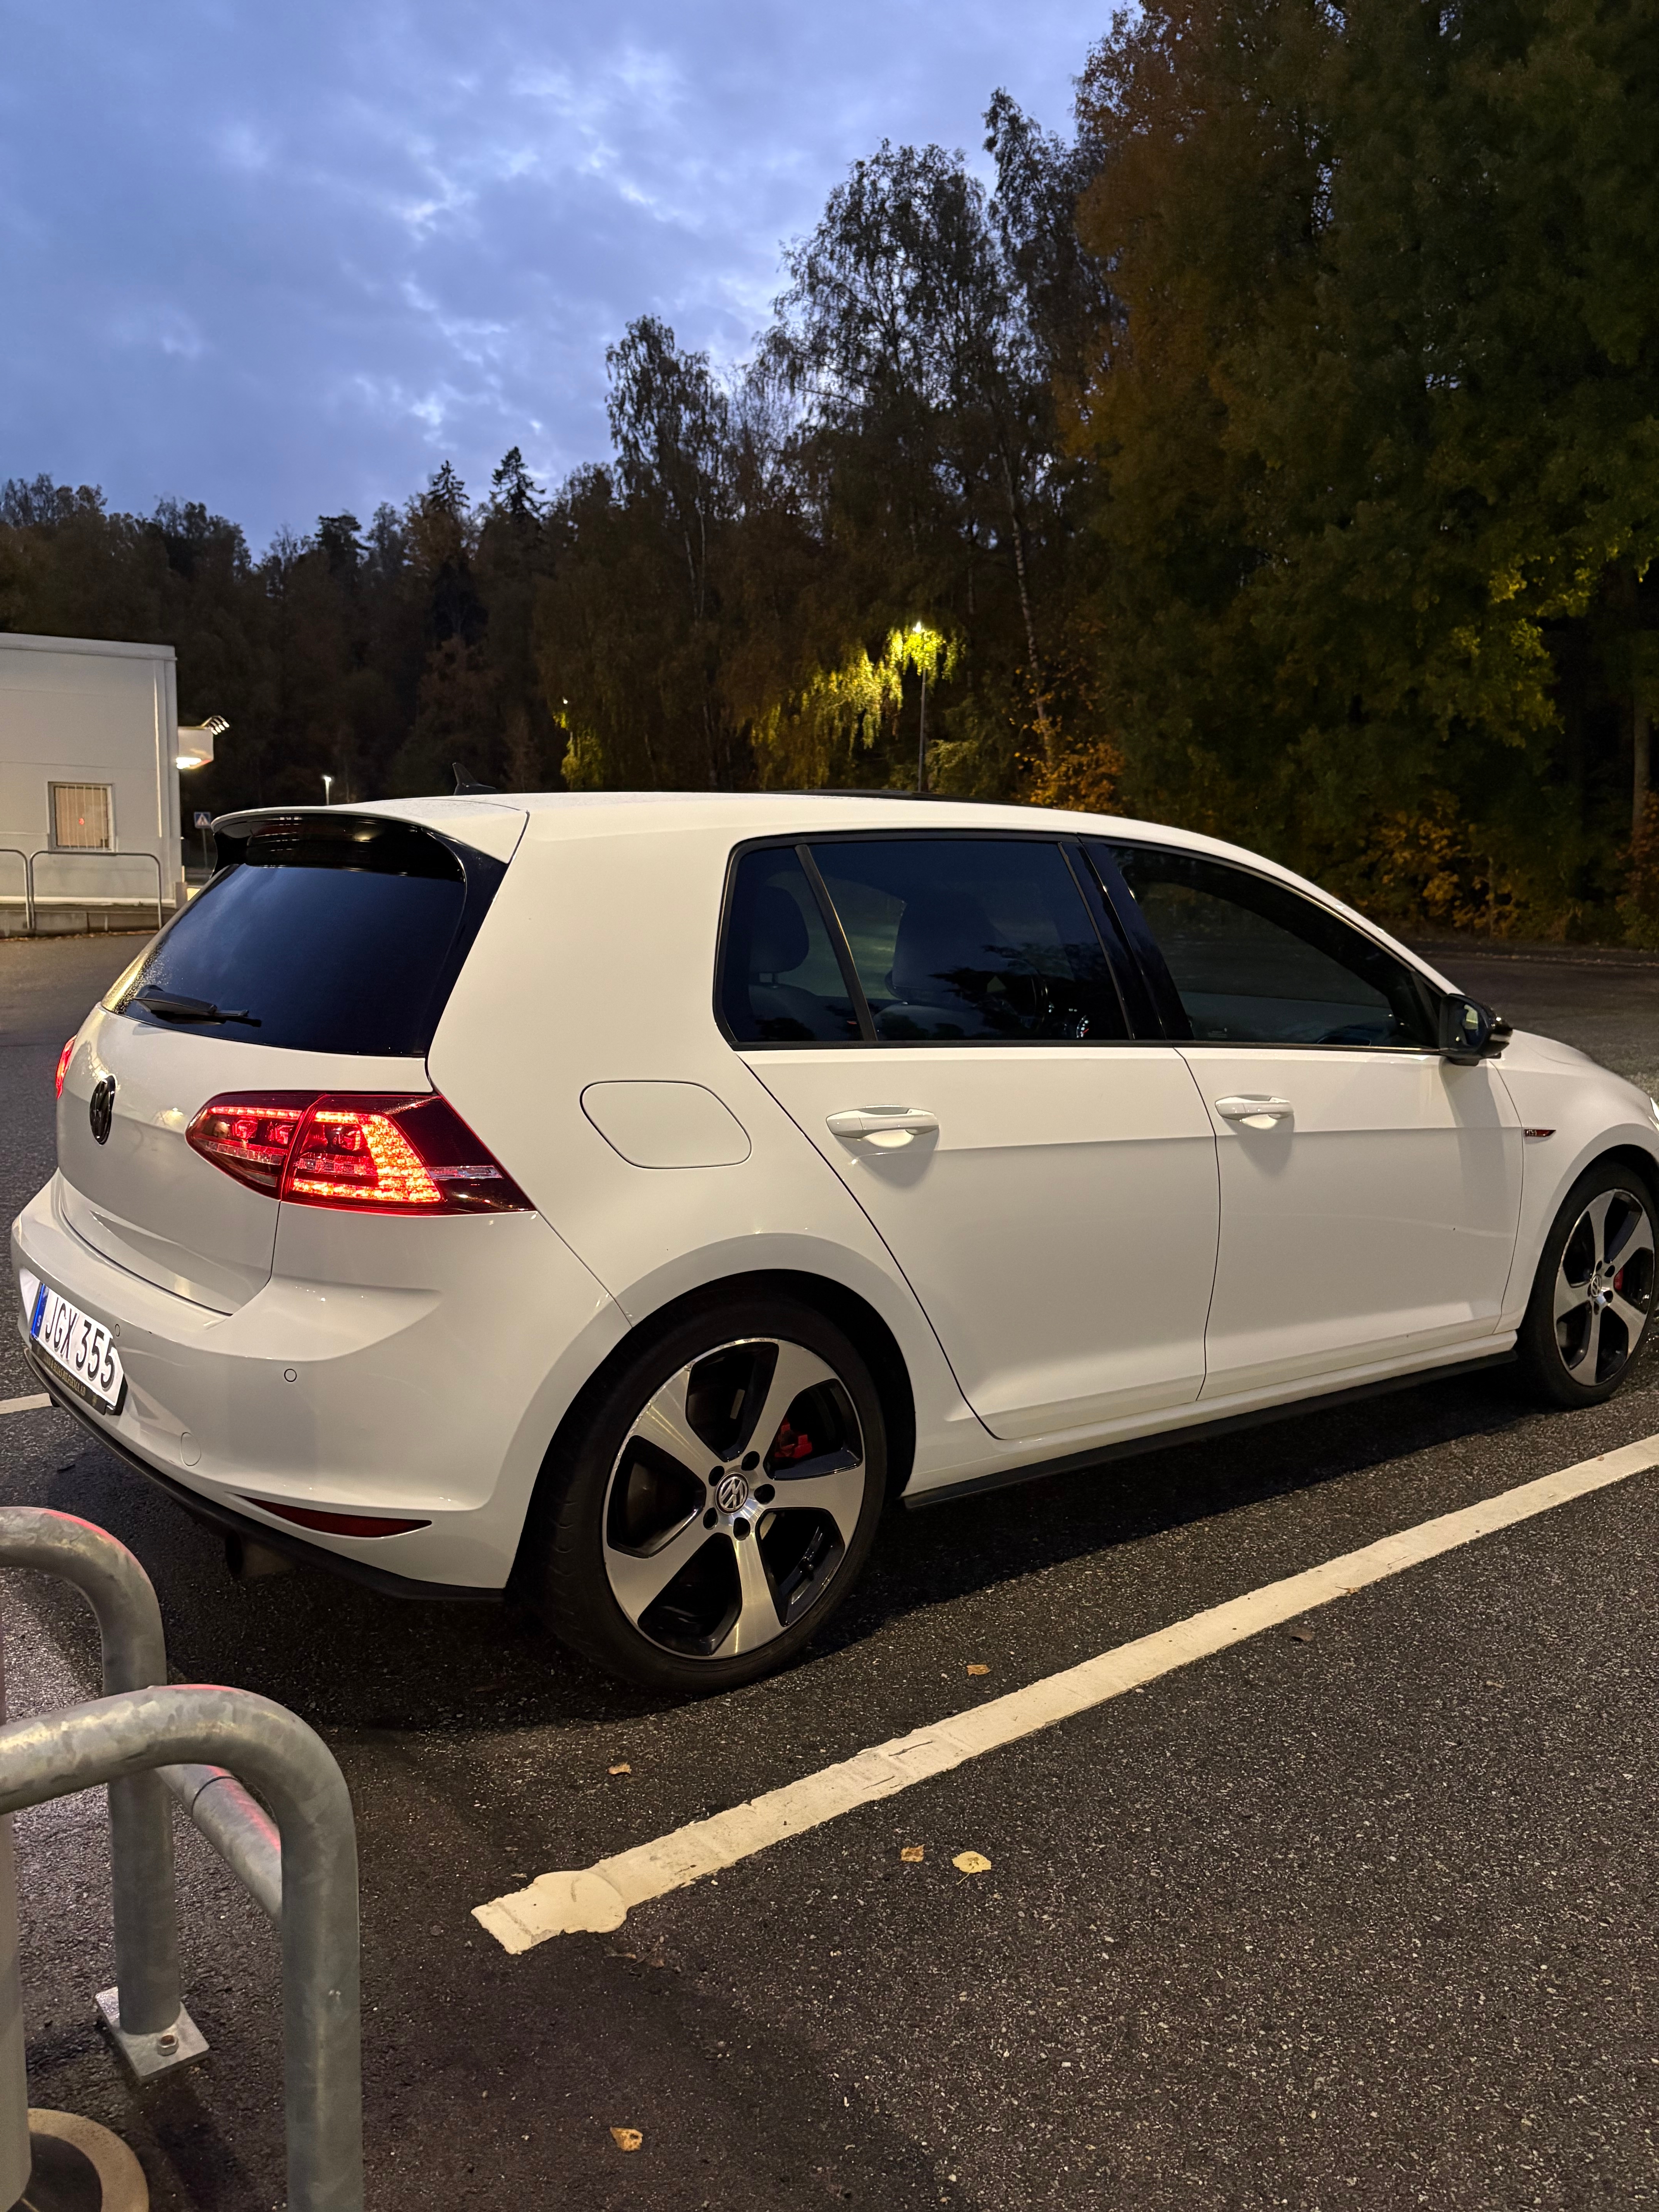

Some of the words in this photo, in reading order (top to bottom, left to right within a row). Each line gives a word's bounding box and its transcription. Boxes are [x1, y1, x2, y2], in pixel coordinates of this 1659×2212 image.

[37, 1315, 41, 1327] S
[45, 1297, 78, 1360] JGX
[76, 1319, 117, 1389] 355
